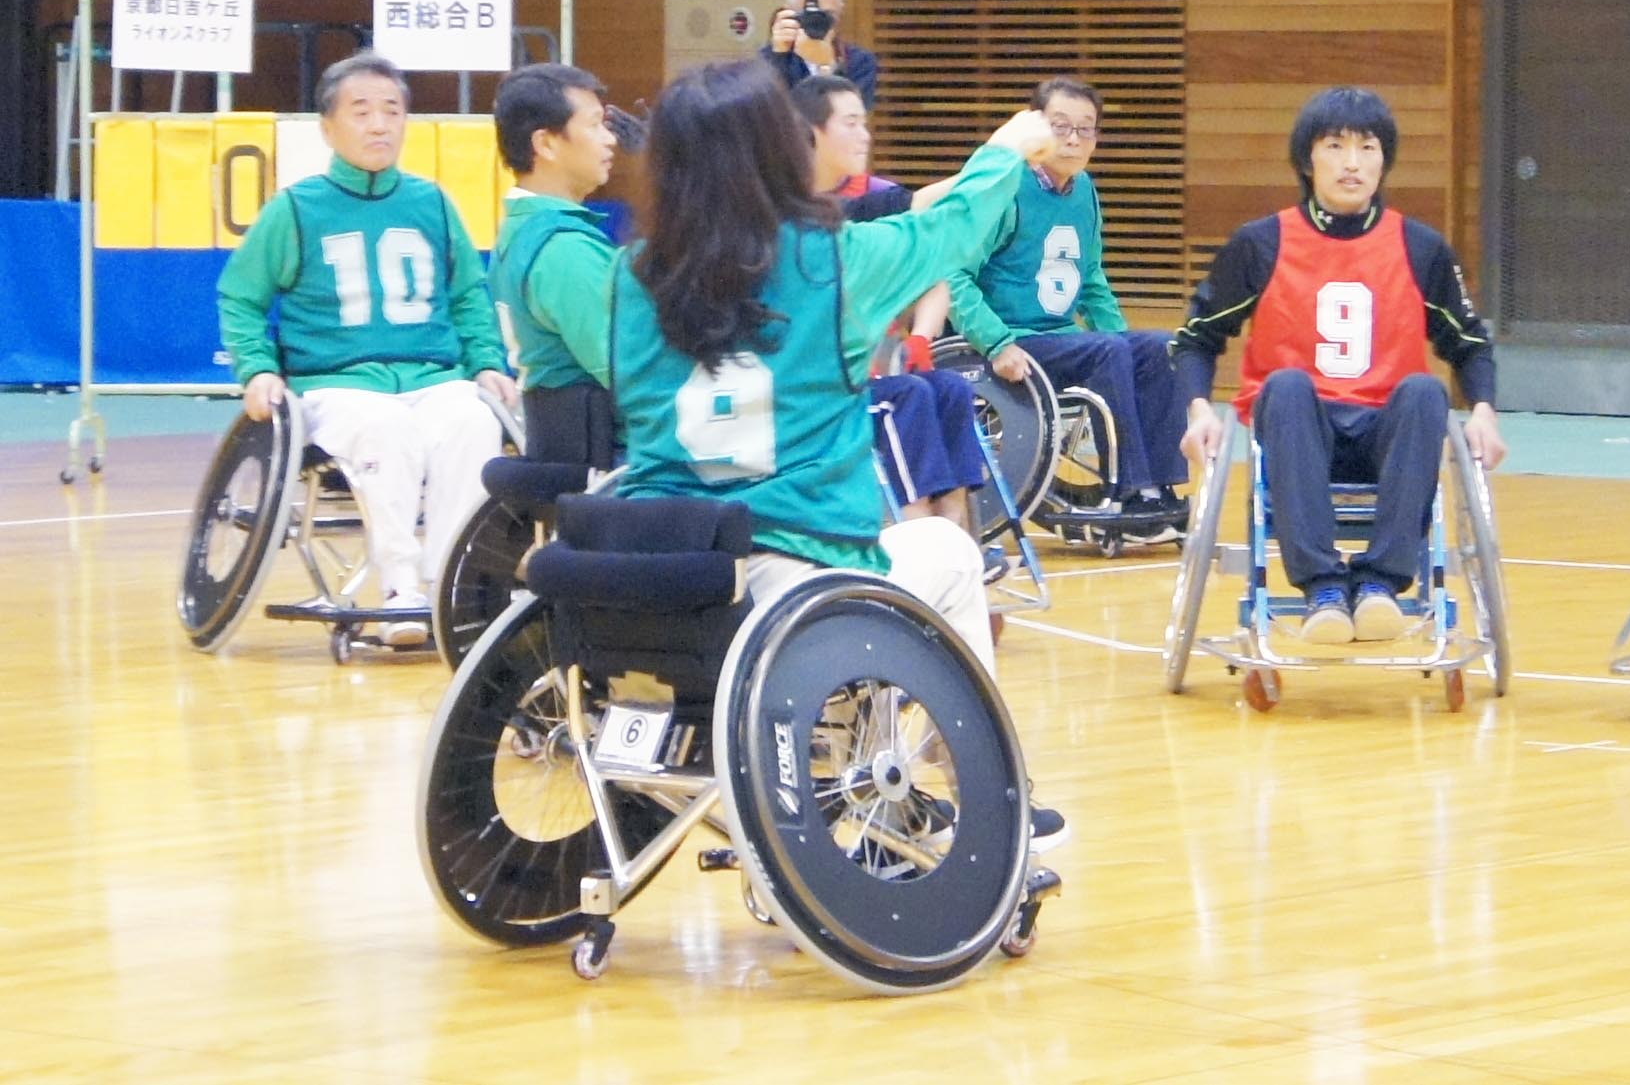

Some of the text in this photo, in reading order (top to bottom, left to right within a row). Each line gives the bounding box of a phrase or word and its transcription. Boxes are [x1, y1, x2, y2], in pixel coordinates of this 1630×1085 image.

[322, 227, 435, 327] 10
[1035, 225, 1082, 315] 6
[1315, 281, 1374, 378] 9
[774, 722, 797, 788] FORCE
